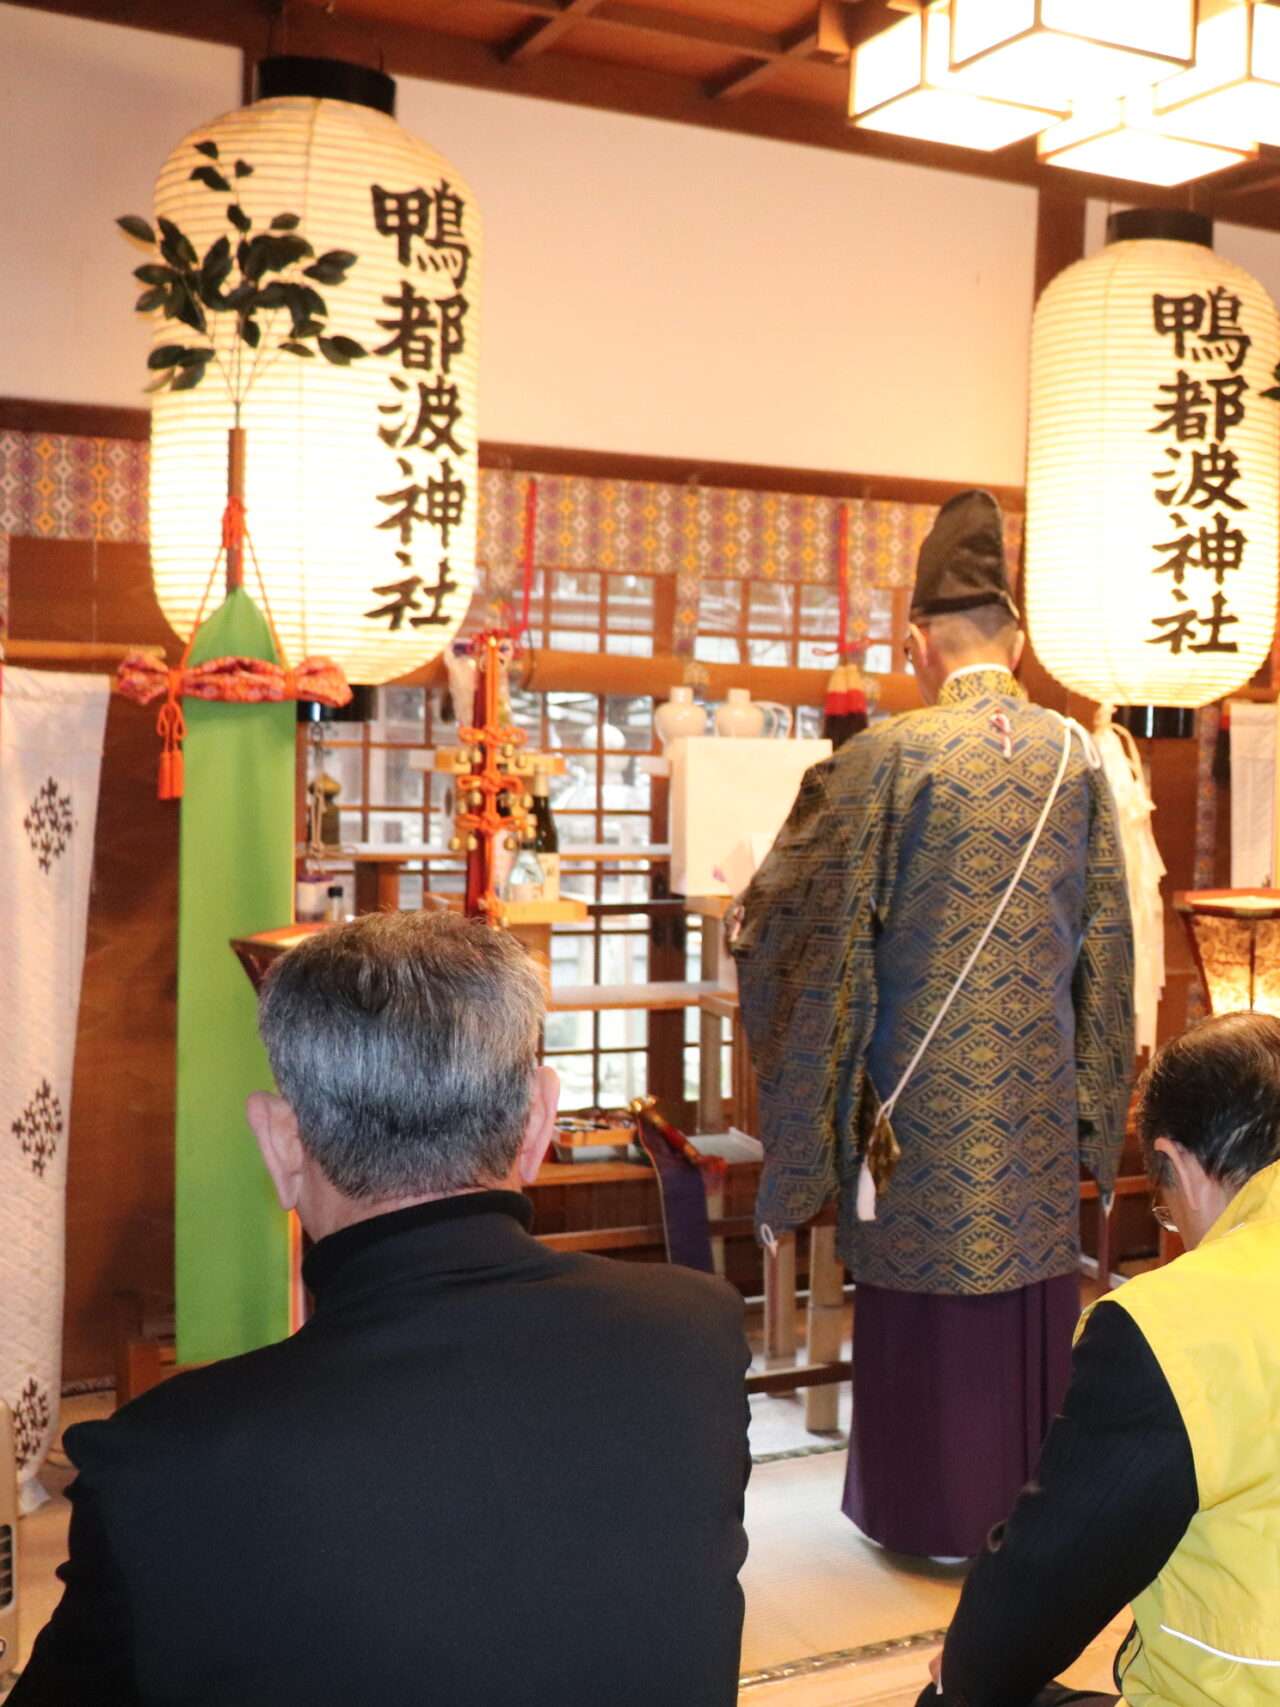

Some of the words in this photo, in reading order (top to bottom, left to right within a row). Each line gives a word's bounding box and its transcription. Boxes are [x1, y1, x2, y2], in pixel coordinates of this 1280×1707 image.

[366, 178, 473, 631] 鴨都波神社
[1147, 285, 1253, 655] 鴨都波神社
